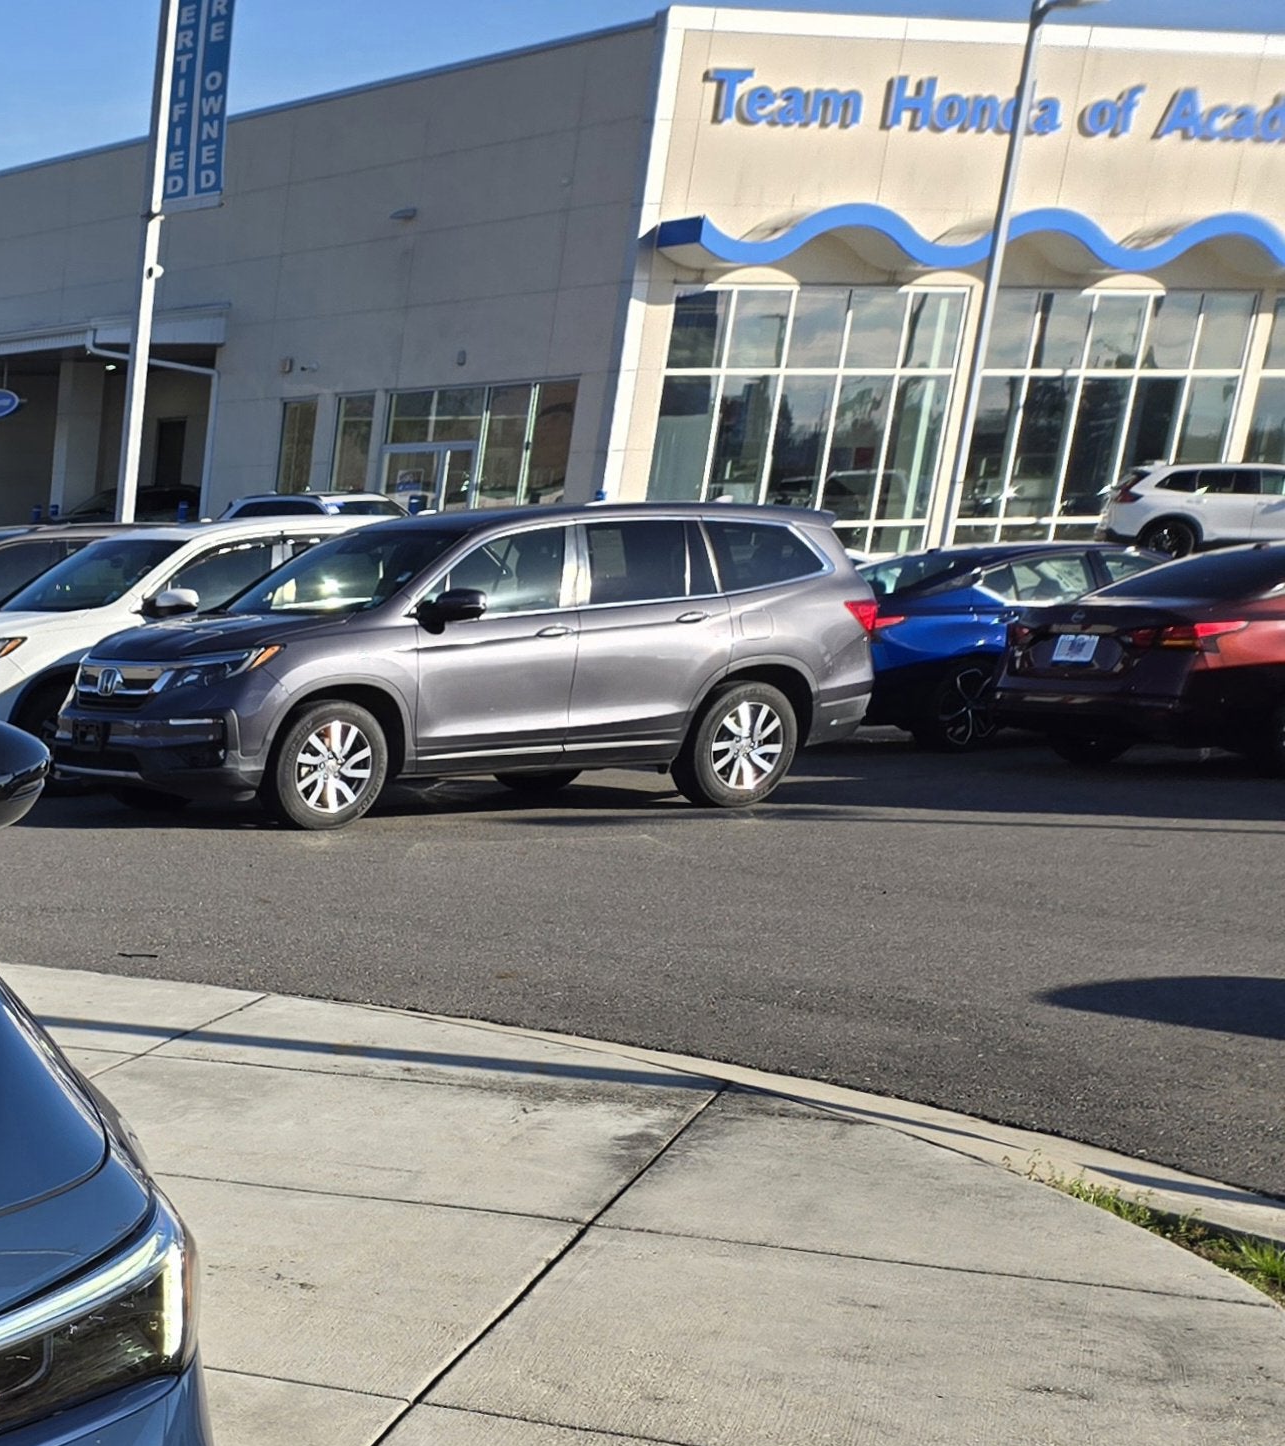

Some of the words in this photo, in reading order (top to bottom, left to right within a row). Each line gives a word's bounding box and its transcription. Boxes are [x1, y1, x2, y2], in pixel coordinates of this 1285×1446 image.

[166, 0, 197, 194] ERTIFIED
[200, 71, 223, 188] OWNED
[704, 67, 863, 128] Team
[1082, 84, 1147, 138] of
